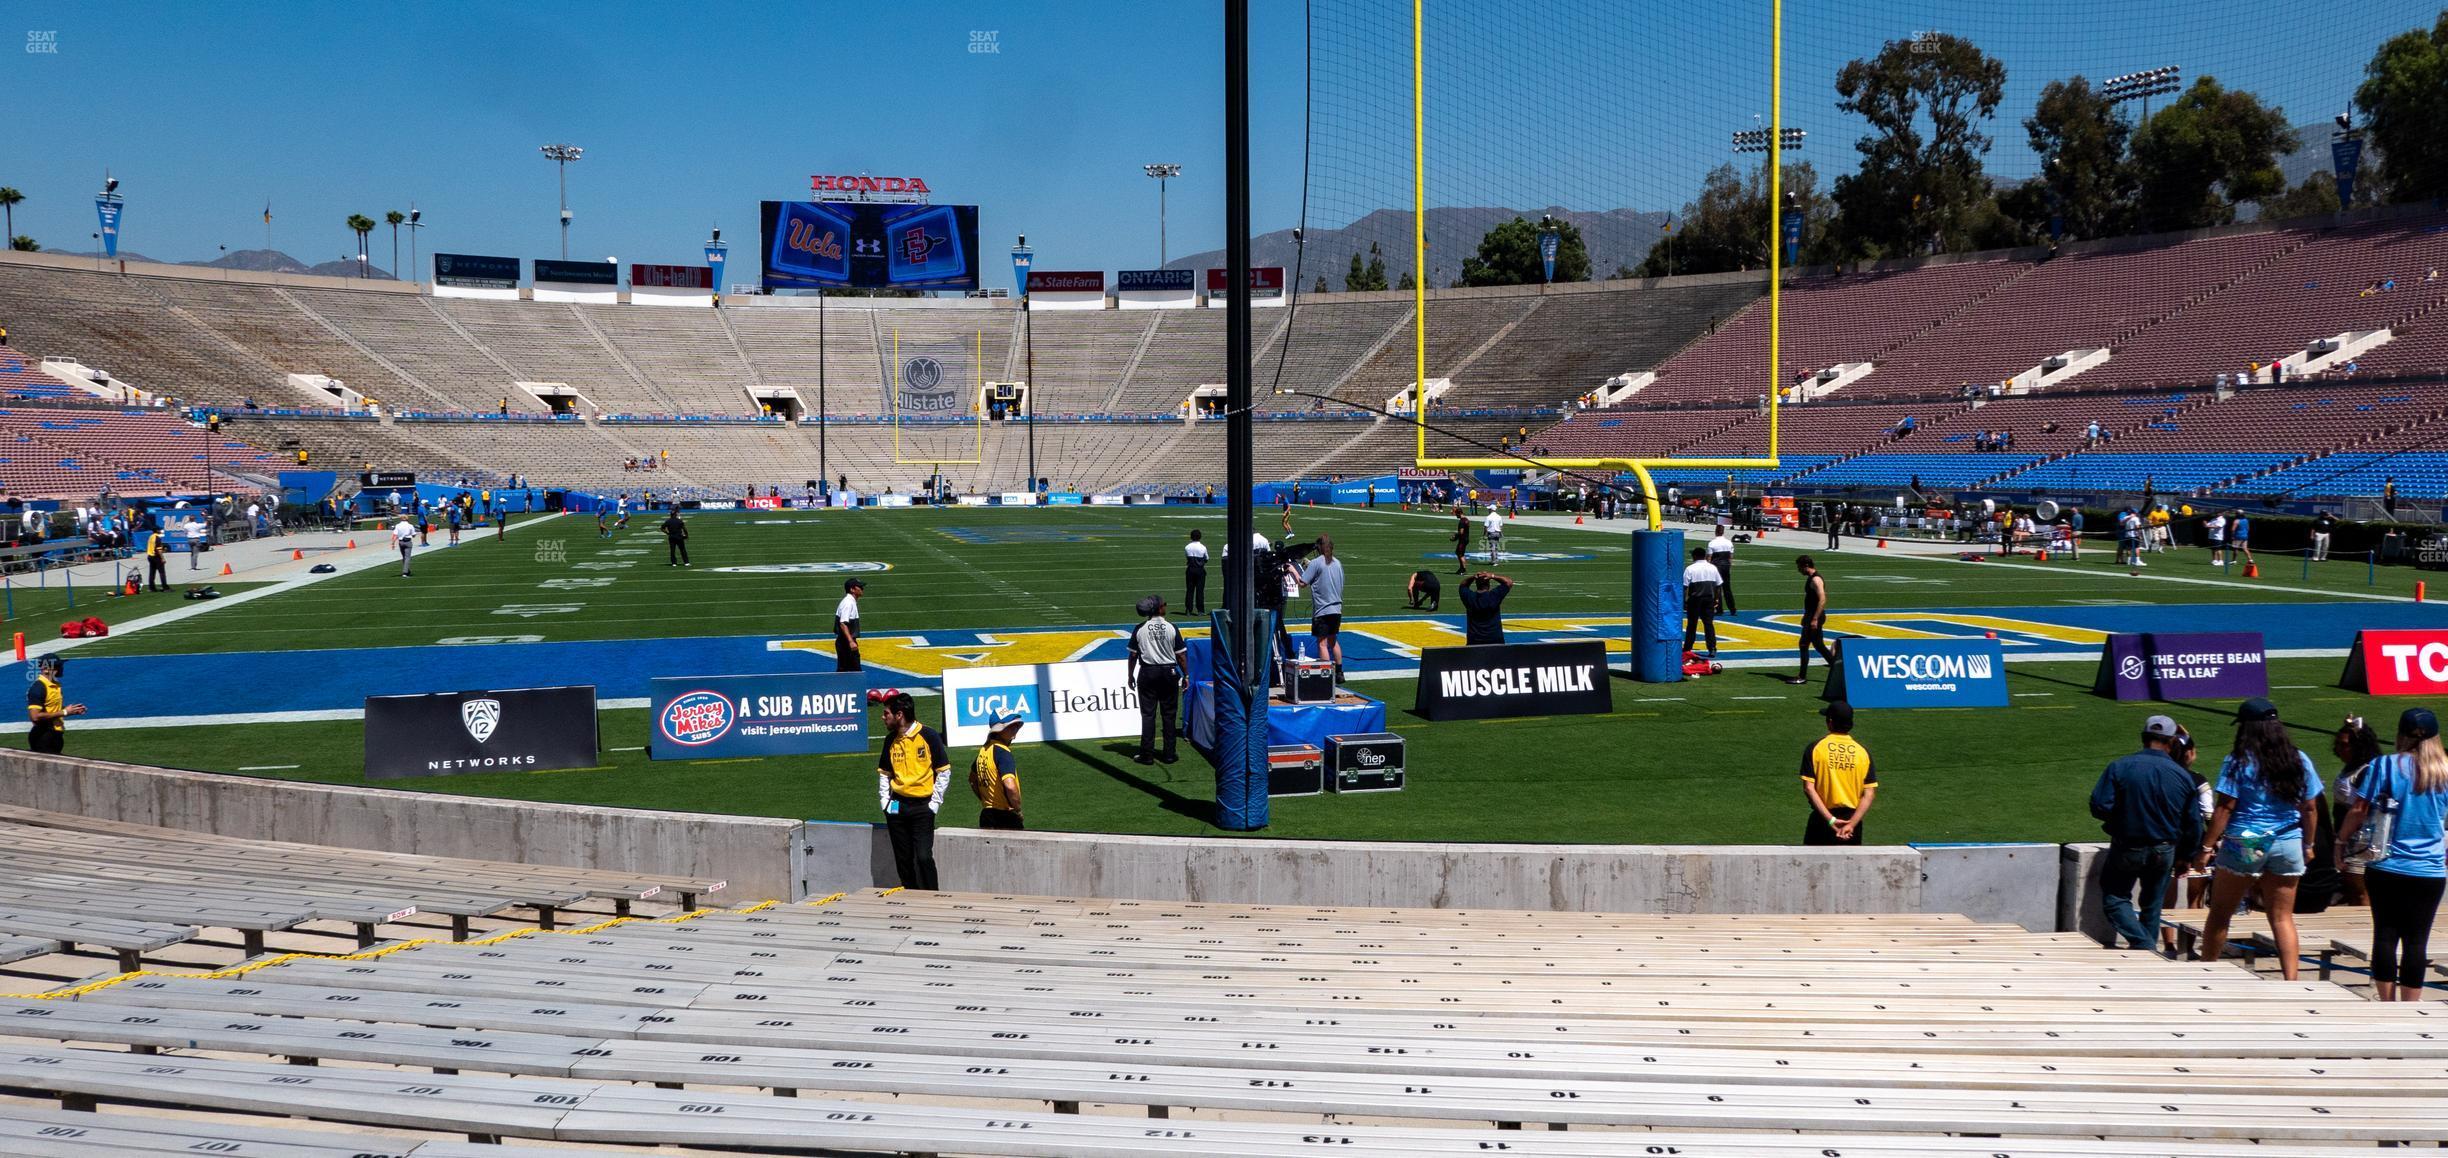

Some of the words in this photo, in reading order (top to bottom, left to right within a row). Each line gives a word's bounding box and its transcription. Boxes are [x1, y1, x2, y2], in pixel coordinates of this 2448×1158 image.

[811, 176, 931, 192] HONDA
[789, 218, 842, 260] Ucla
[893, 392, 955, 410] Allstate
[1400, 468, 1447, 477] HONDA
[753, 499, 777, 508] TCL
[163, 515, 190, 531] Ucl
[1148, 623, 1167, 631] CSC
[2151, 655, 2175, 665] THE
[2177, 653, 2225, 664] COFFEE
[2227, 652, 2261, 664] BEAN
[1857, 654, 1966, 679] WESCOM
[2161, 668, 2187, 679] TEA
[2188, 667, 2219, 678] LEAF
[1440, 668, 1532, 698] MUSCLE
[1536, 665, 1594, 693] MILK
[1905, 683, 1956, 692] wescom.org
[739, 697, 751, 717] A
[758, 696, 793, 717] SUB
[800, 693, 862, 716] ABOVE.
[1048, 686, 1140, 714] Health
[465, 701, 498, 726] PAC
[670, 702, 724, 723] Jersey
[475, 722, 489, 735] 12
[741, 726, 767, 737] visit:
[769, 723, 858, 738] jerseymikes.com
[691, 731, 712, 741] SUBS
[1827, 742, 1856, 754] CSC
[428, 755, 536, 770] NETWORKS
[1365, 754, 1386, 766] nep
[1828, 752, 1856, 763] EVENT
[1829, 761, 1856, 771] STAFF
[392, 911, 406, 920] ROW
[534, 1095, 579, 1104] 108
[679, 1105, 723, 1113] 109
[38, 1128, 86, 1137] 106
[1303, 1136, 1353, 1144] 113
[190, 1142, 240, 1151] 107
